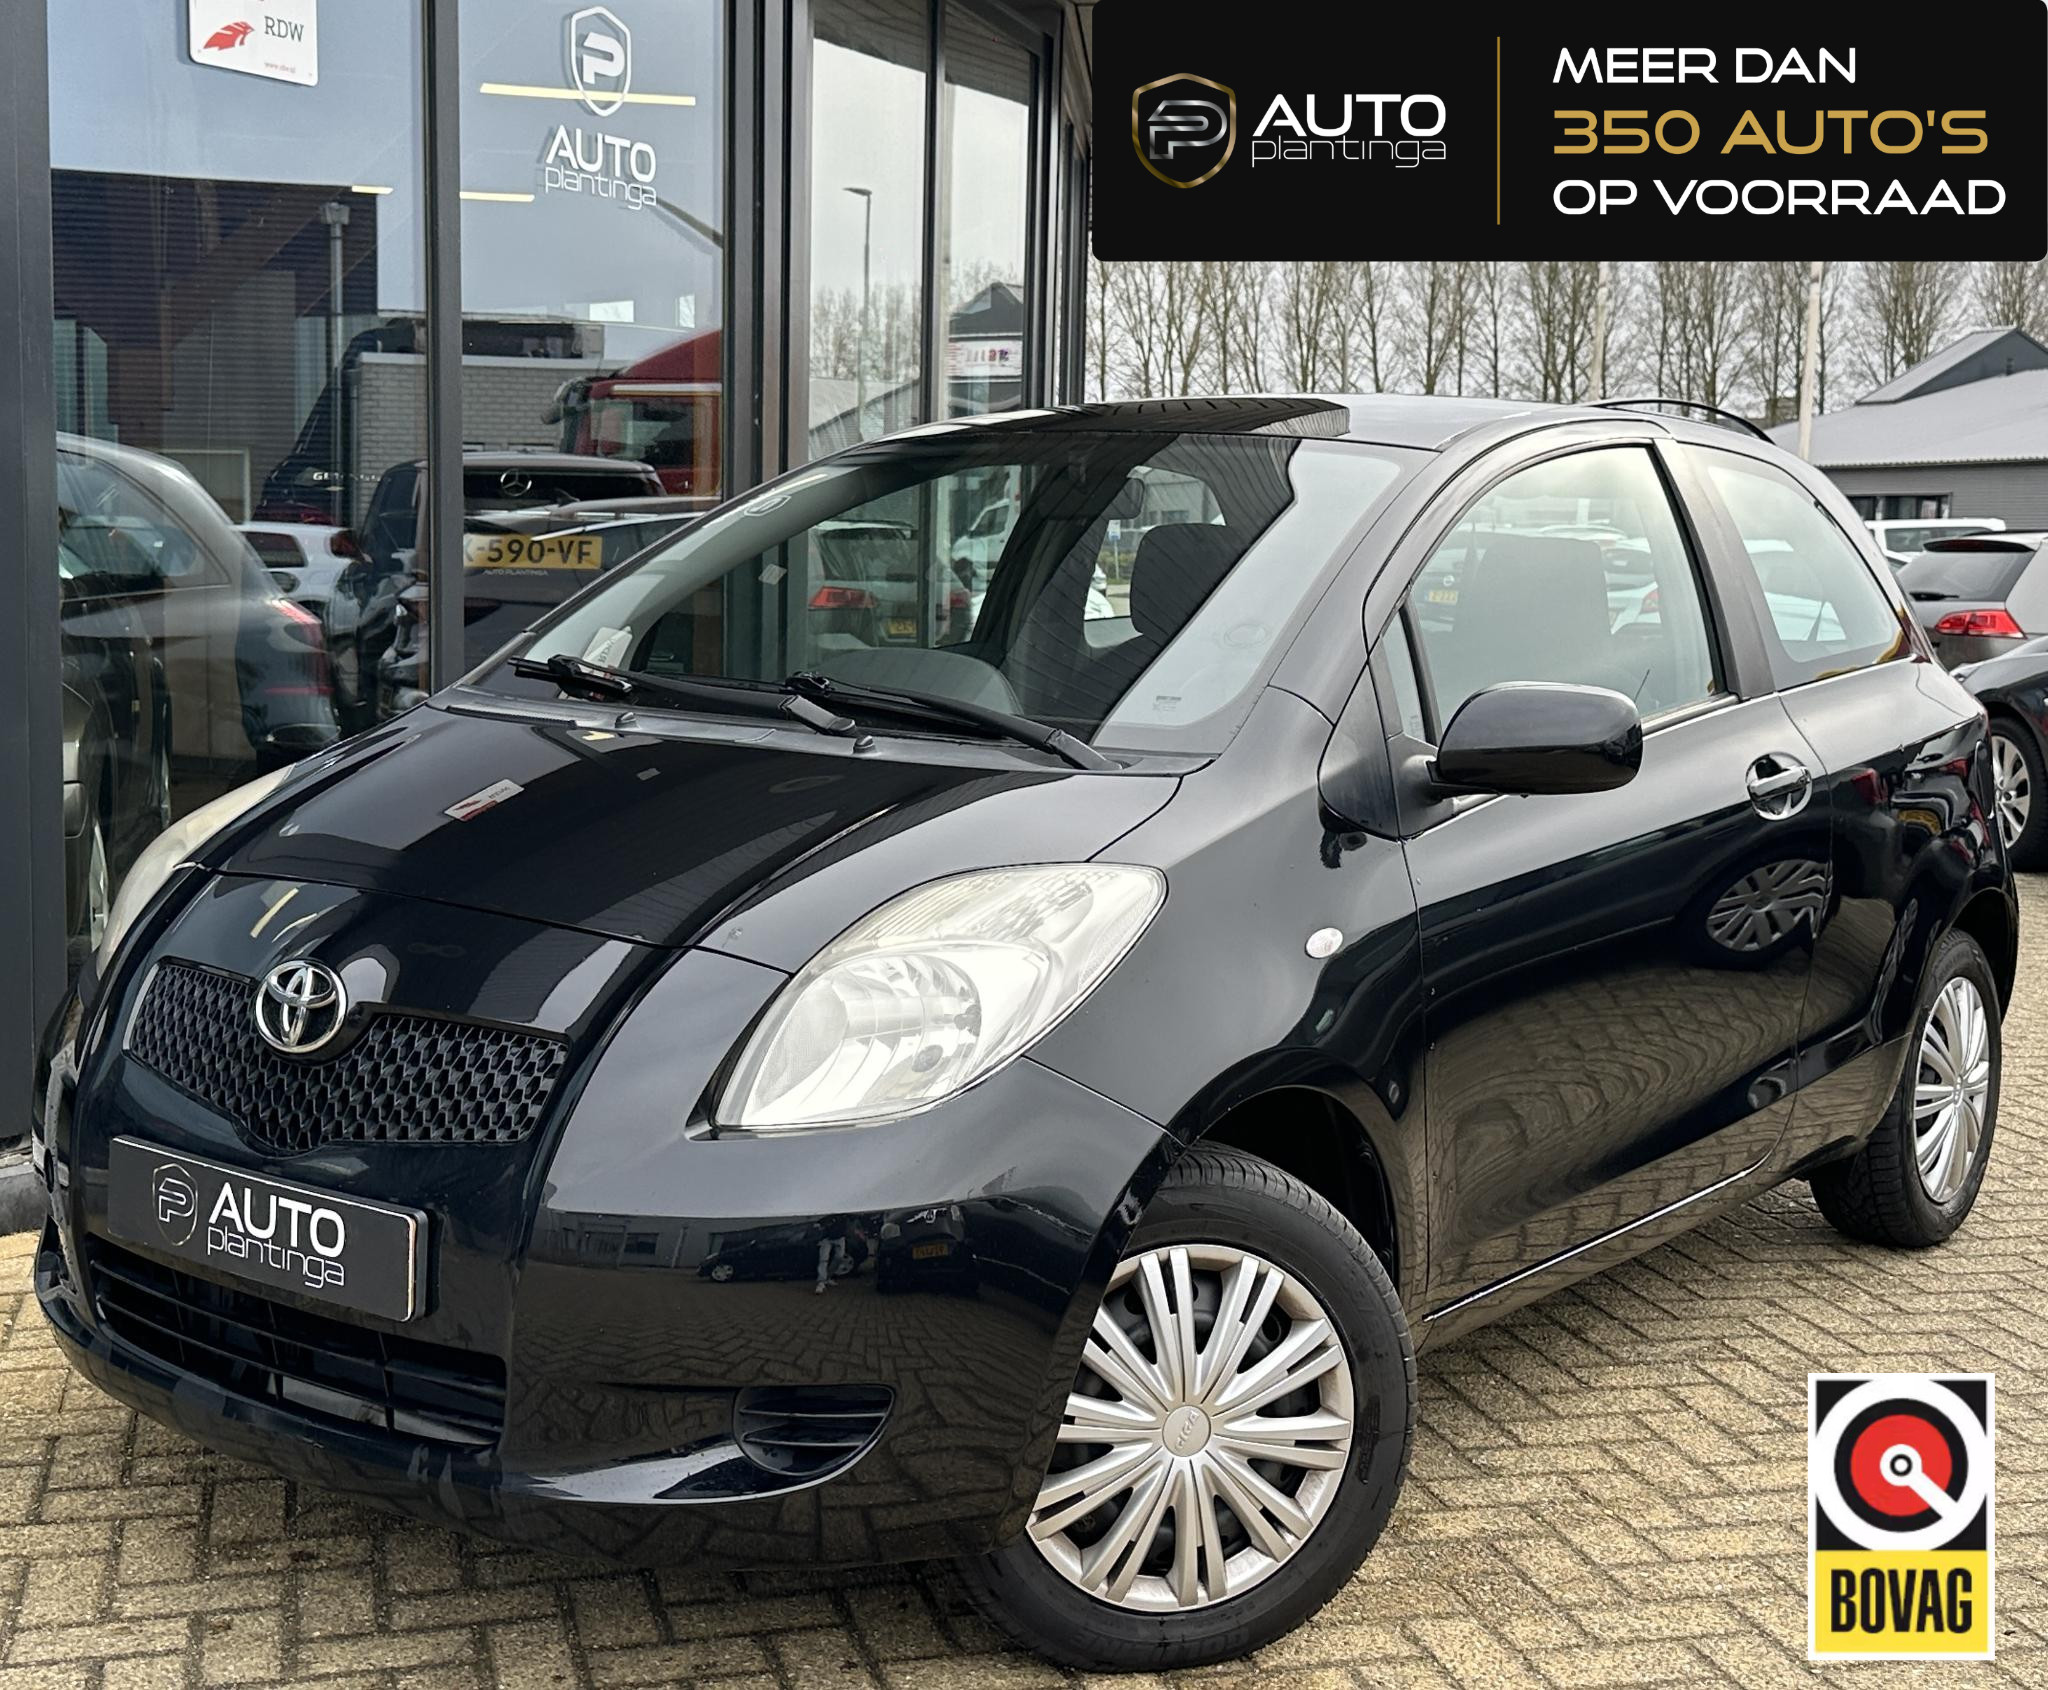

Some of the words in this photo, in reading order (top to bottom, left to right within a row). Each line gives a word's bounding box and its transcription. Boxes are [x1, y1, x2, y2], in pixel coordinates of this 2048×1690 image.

[264, 15, 304, 42] RDW
[545, 124, 657, 183] AUTO
[544, 164, 658, 211] plantinga
[208, 1181, 346, 1258] AUTO
[207, 1225, 346, 1289] plantinga
